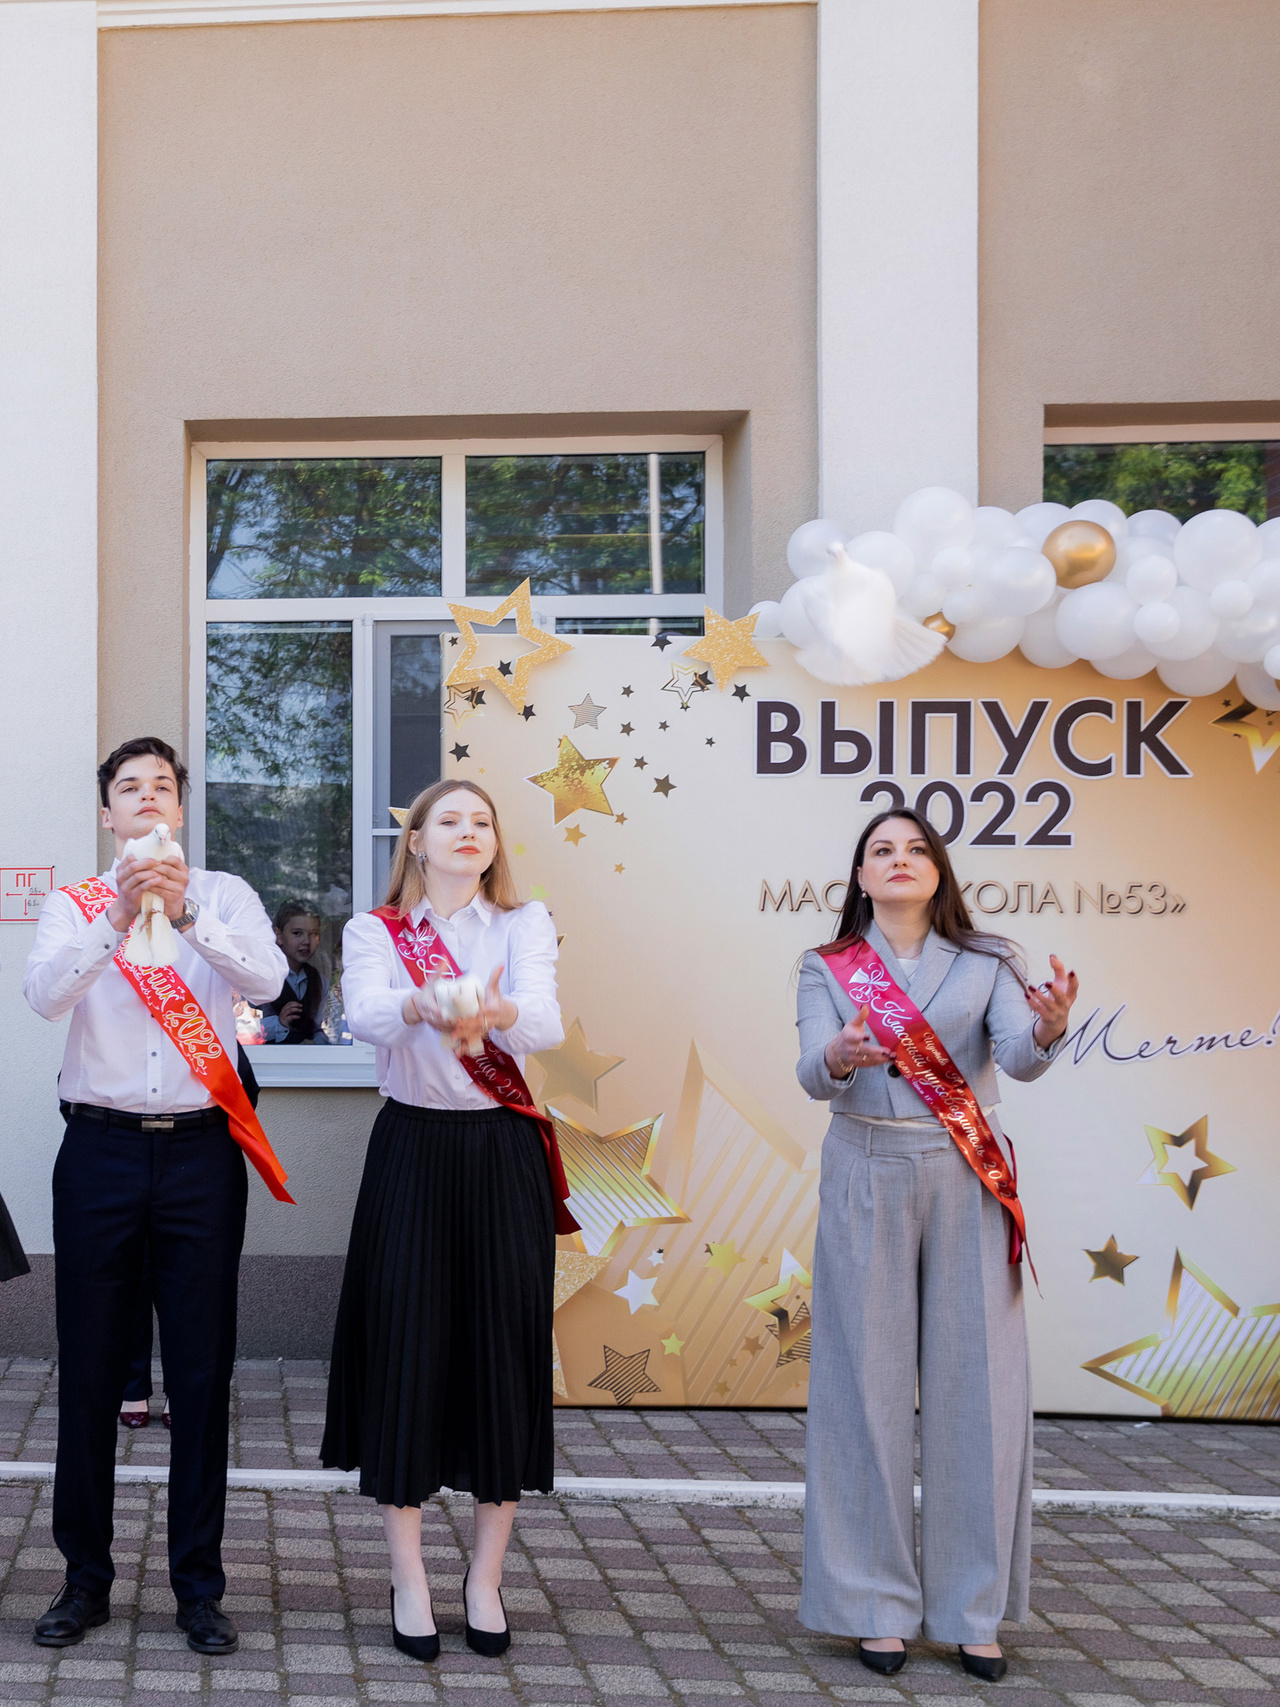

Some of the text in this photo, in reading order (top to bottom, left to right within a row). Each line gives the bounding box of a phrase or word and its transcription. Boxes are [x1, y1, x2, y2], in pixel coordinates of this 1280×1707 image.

[756, 699, 1190, 777] ВЫПУСК
[16, 873, 36, 887] ПГ
[759, 879, 1186, 915] МАО ОЛА №53»
[164, 1003, 222, 1067] 2022
[871, 994, 931, 1068] Классный
[914, 1064, 985, 1158] руководитель
[982, 1161, 1012, 1199] 2022
